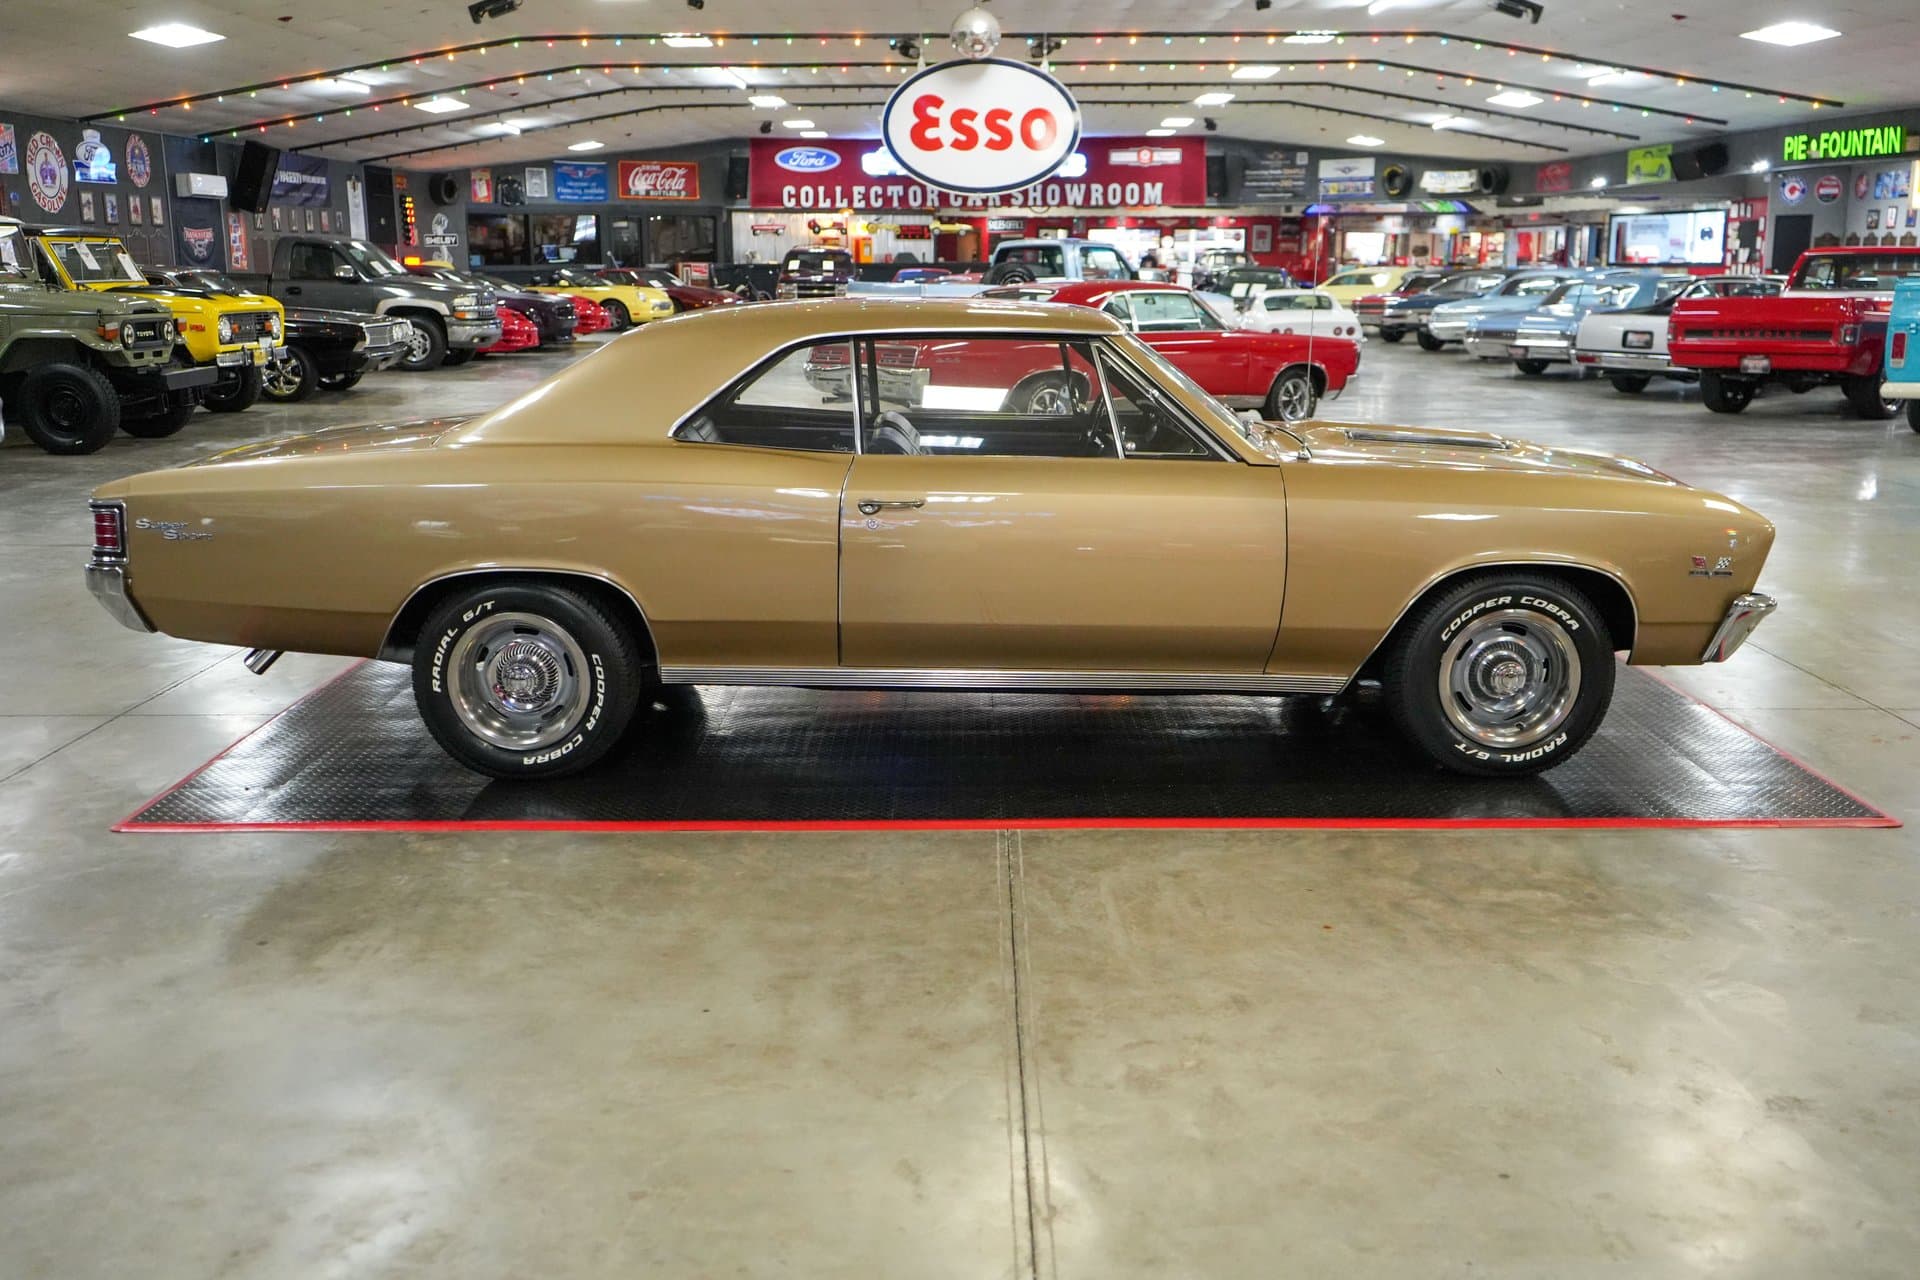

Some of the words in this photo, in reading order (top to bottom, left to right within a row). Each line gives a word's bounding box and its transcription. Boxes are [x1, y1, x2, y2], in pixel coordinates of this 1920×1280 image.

[26, 138, 39, 166] RED
[1783, 134, 1808, 160] PIE
[1819, 125, 1901, 158] FOUNTAIN
[788, 150, 827, 167] Ford
[628, 166, 689, 191] Coca-Cola
[31, 181, 67, 213] GASOLINE
[782, 183, 940, 209] COLLECTOR
[1009, 182, 1164, 207] SHOWROOM
[425, 235, 457, 245] SHELBY
[136, 330, 155, 338] TOYOTA
[135, 517, 191, 532] Super
[1440, 595, 1513, 643] COOPER
[1519, 595, 1581, 632] COBRA
[431, 626, 459, 694] RADIAL
[462, 600, 496, 623] G/T
[585, 653, 606, 732] COOPER
[522, 733, 584, 766] COBRA
[1453, 742, 1491, 761] G/T
[1500, 731, 1568, 763] RADIAL
